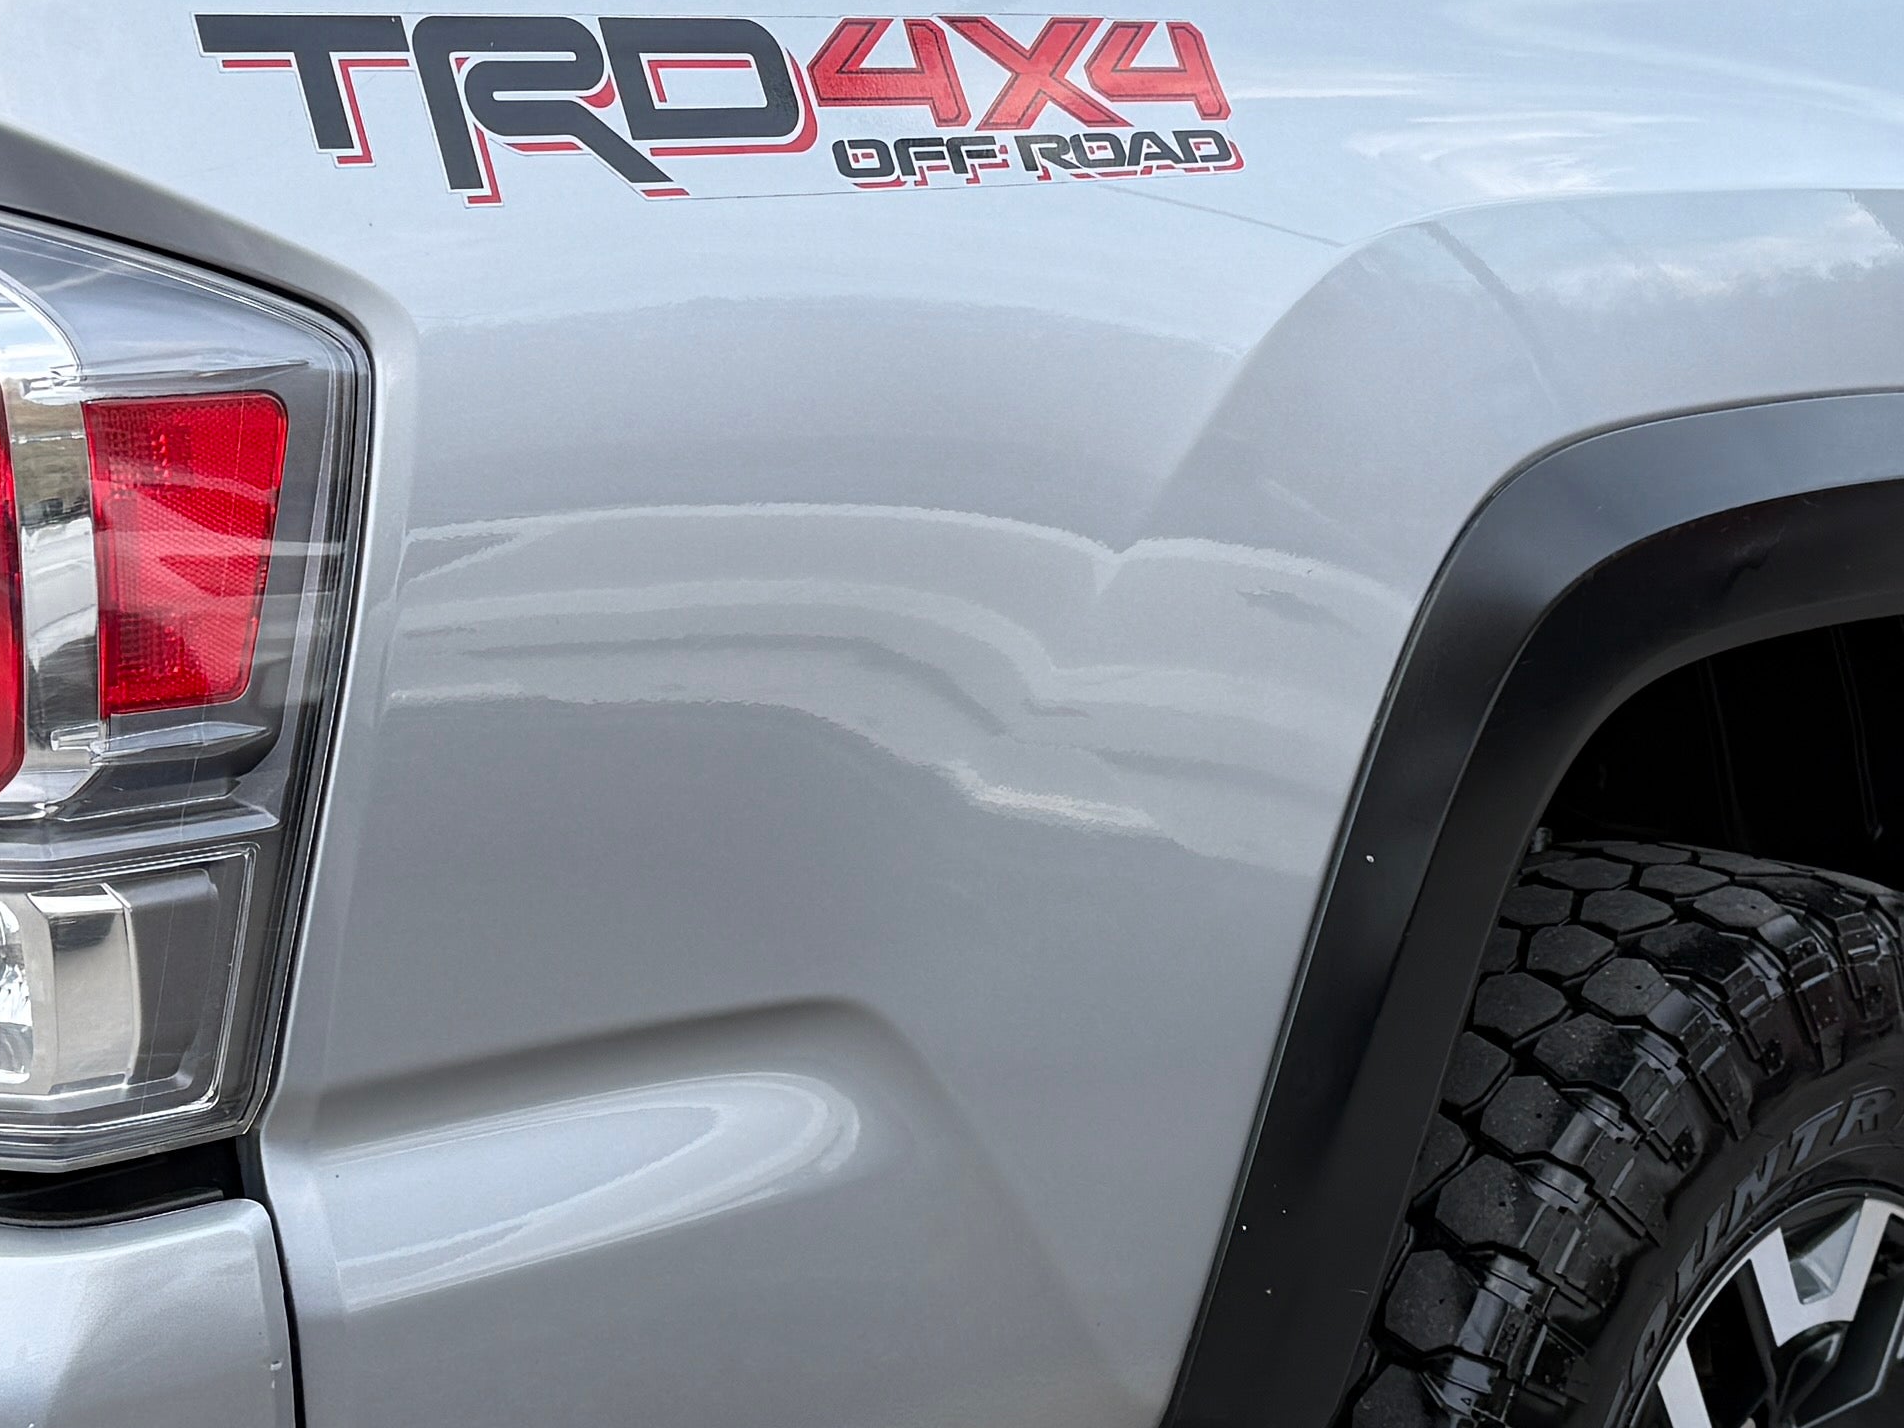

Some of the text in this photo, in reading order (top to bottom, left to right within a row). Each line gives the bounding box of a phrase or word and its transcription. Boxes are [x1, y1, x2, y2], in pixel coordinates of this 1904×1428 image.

[194, 13, 1232, 208] TRD 4X4
[831, 129, 1246, 187] OFF ROAD
